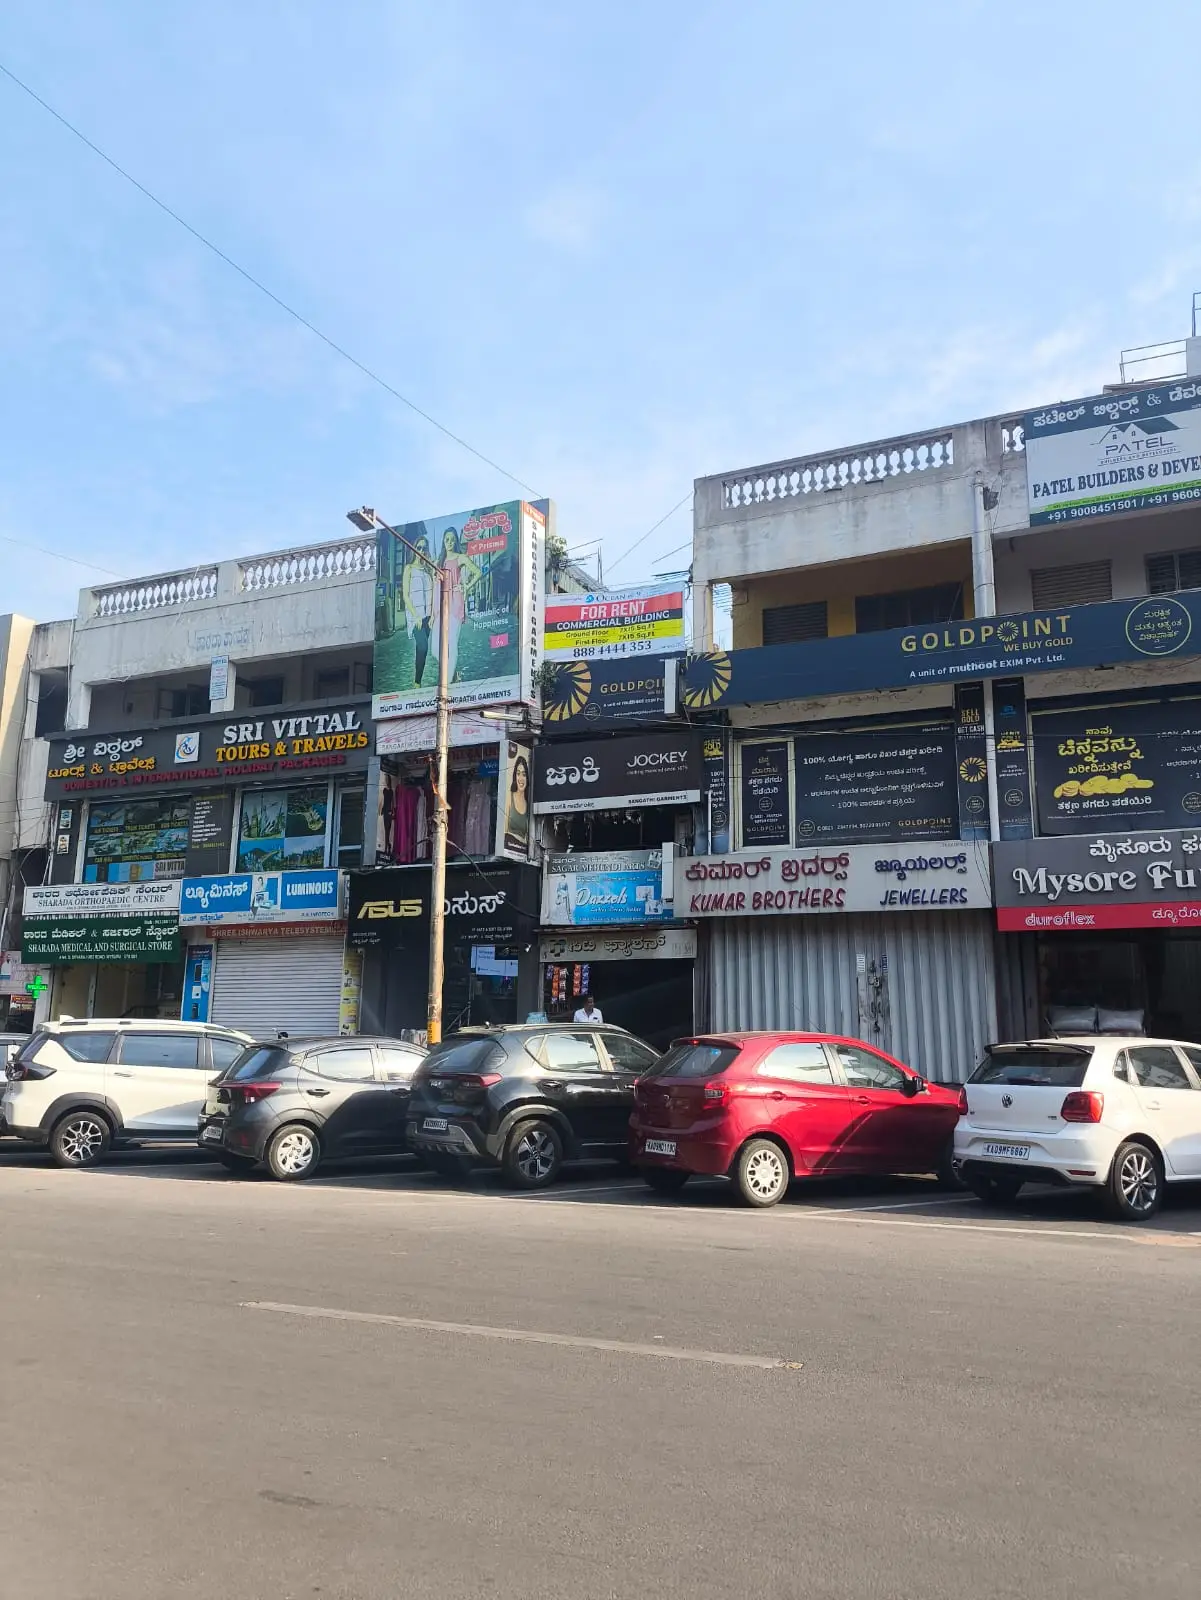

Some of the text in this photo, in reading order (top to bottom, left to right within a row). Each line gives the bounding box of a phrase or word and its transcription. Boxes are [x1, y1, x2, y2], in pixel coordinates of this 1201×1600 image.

[1147, 394, 1162, 405] &
[1106, 436, 1174, 456] PATEL
[1033, 478, 1075, 498] PATEL
[1078, 465, 1145, 490] BUILDERS
[1148, 463, 1159, 477] &
[1047, 511, 1067, 522] +91
[1070, 499, 1137, 518] 9008451501
[1148, 493, 1168, 505] +91
[1172, 488, 1201, 502] 9606
[478, 540, 505, 550] Prisma
[580, 600, 649, 620] FOR RENT
[473, 618, 509, 630] Happiness
[557, 610, 670, 631] COMMERCIAL BUILDING
[566, 631, 591, 639] Ground
[575, 638, 591, 646] First
[591, 637, 609, 645] Floor
[573, 647, 595, 658] 888
[597, 643, 626, 655] 4444
[629, 640, 652, 652] 353
[1003, 636, 1074, 653] WE BUY GOLD
[909, 653, 1066, 678] A unit of muthoot EXIM Pvt. Ltd.
[448, 690, 511, 705] ANGAATHI GARMENTS
[223, 711, 361, 745] SRI VITTAL
[969, 724, 985, 733] CASH
[63, 738, 86, 763] ಶ್ರೀ
[215, 732, 368, 763] TOURS & TRAVELS
[626, 750, 688, 768] JOCKEY
[803, 756, 826, 765] 100%
[90, 762, 103, 775] &
[130, 767, 220, 786] INTERNATIONAL
[1089, 836, 1172, 863] ಮೈಸೂರು
[685, 856, 771, 881] ಕುಮಾರ್
[781, 852, 850, 882] ಬ್ರದರ್ಸ್
[286, 881, 334, 896] LUMINOUS
[1012, 860, 1201, 901] Mysore Fu
[38, 898, 75, 908] SHARADA
[74, 896, 131, 906] ORTHOPAEDIC
[132, 894, 165, 903] CENTRE
[689, 887, 968, 912] KUMAR BROTHERS JEWELLERS
[356, 898, 423, 920] ASUS
[1025, 911, 1096, 927] duroflex
[212, 928, 279, 938] SHREE ISHWARYA
[28, 940, 173, 953] SHARADA MEDICAL AND SURGICAL STORE
